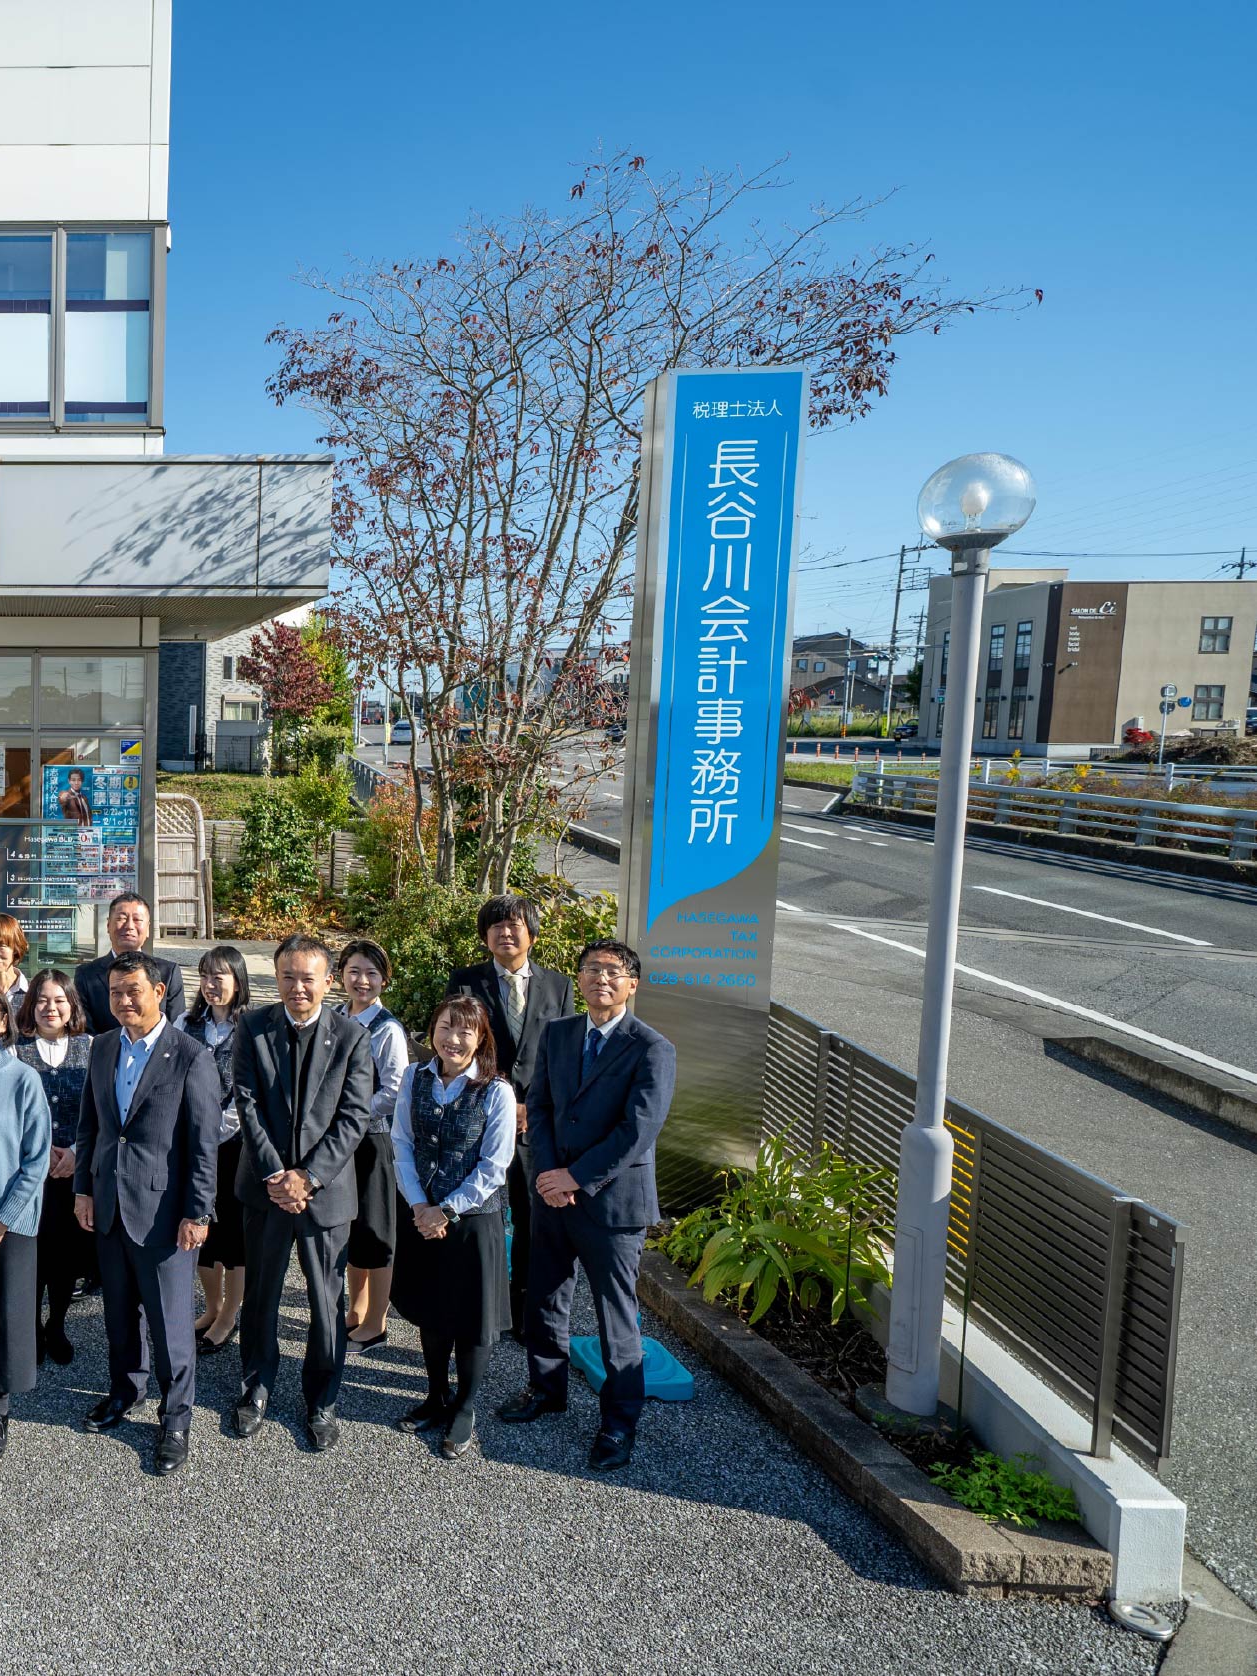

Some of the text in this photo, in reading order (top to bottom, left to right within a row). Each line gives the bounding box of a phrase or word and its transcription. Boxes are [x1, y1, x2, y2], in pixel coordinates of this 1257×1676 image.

[692, 399, 783, 419] 税理士法人
[687, 439, 760, 845] 長谷川会計事務所
[94, 776, 122, 790] 冬期
[93, 791, 137, 805] 講習会
[677, 911, 759, 924] HASEGAWA
[730, 930, 757, 941] TAX
[650, 946, 757, 960] CORPORATION
